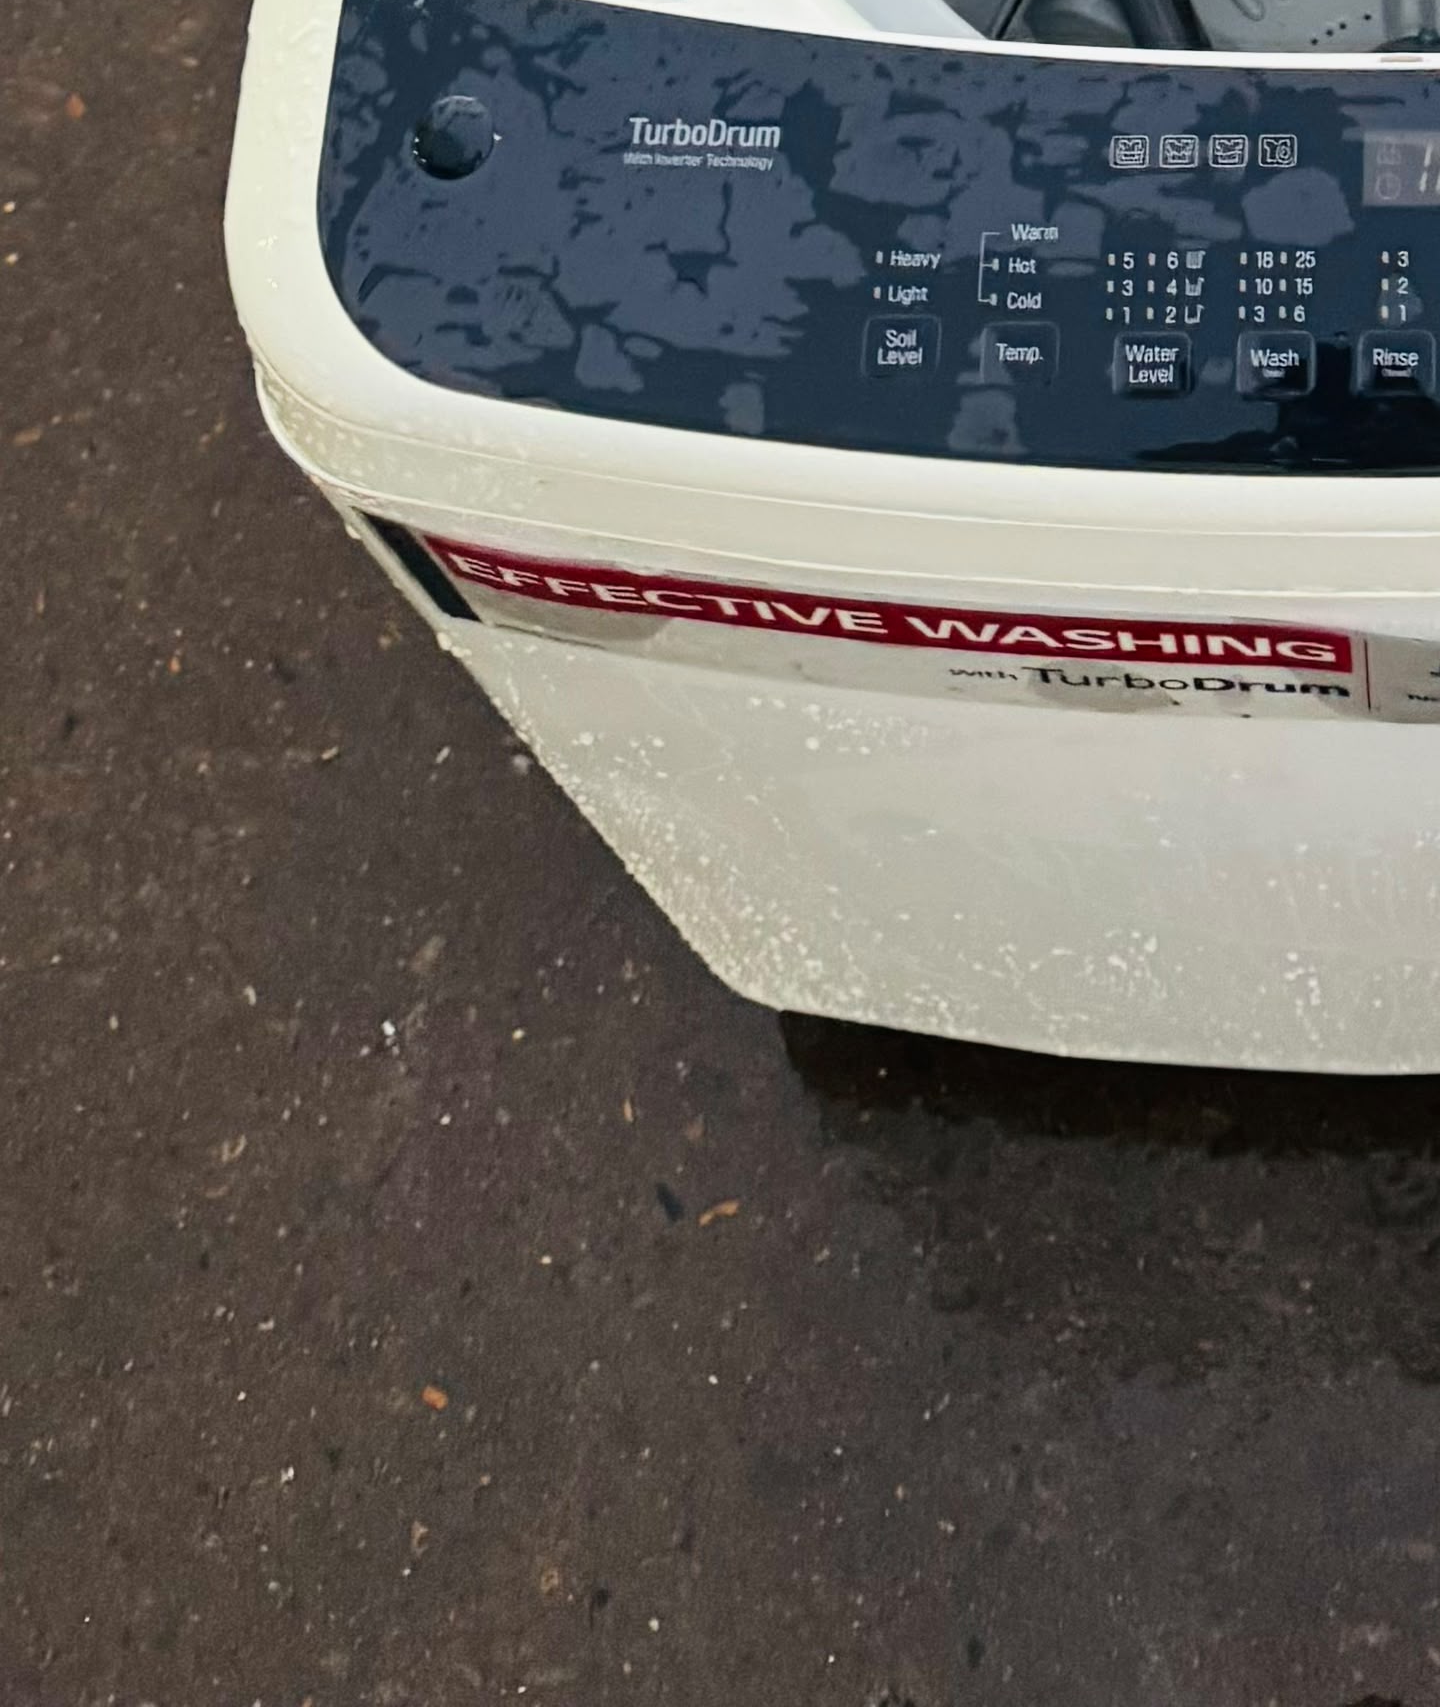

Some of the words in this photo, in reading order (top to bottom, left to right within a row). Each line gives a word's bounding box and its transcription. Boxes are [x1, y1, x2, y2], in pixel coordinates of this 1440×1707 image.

[629, 117, 780, 148] TurboDrum
[706, 153, 774, 172] Technology
[1011, 224, 1059, 242] Warm
[890, 250, 941, 270] Heavy
[1008, 258, 1036, 274] Hot
[1123, 252, 1135, 269] 5
[1167, 252, 1179, 269] 6
[1256, 251, 1274, 268] 18
[1296, 251, 1316, 268] 25
[1397, 251, 1410, 267] 3
[888, 286, 929, 305] Light
[1122, 279, 1134, 296] 3
[1166, 279, 1178, 296] 4
[1255, 278, 1273, 295] 10
[1295, 278, 1314, 295] 15
[1396, 278, 1410, 295] 2
[1007, 292, 1042, 310] Cold
[1123, 306, 1131, 324] 1
[1165, 306, 1177, 324] 2
[1254, 306, 1265, 323] 3
[1294, 306, 1306, 323] 6
[1398, 305, 1407, 321] 1
[885, 328, 917, 347] Soil
[877, 347, 923, 365] Level
[995, 343, 1044, 365] Temp.
[1125, 344, 1180, 363] Water
[1250, 349, 1300, 367] Wash
[1372, 347, 1420, 367] Rinse
[1129, 364, 1174, 384] Level
[446, 552, 890, 635] EFFECTIVE
[905, 614, 1339, 664] WASHING
[1023, 665, 1352, 700] TurboDrum
